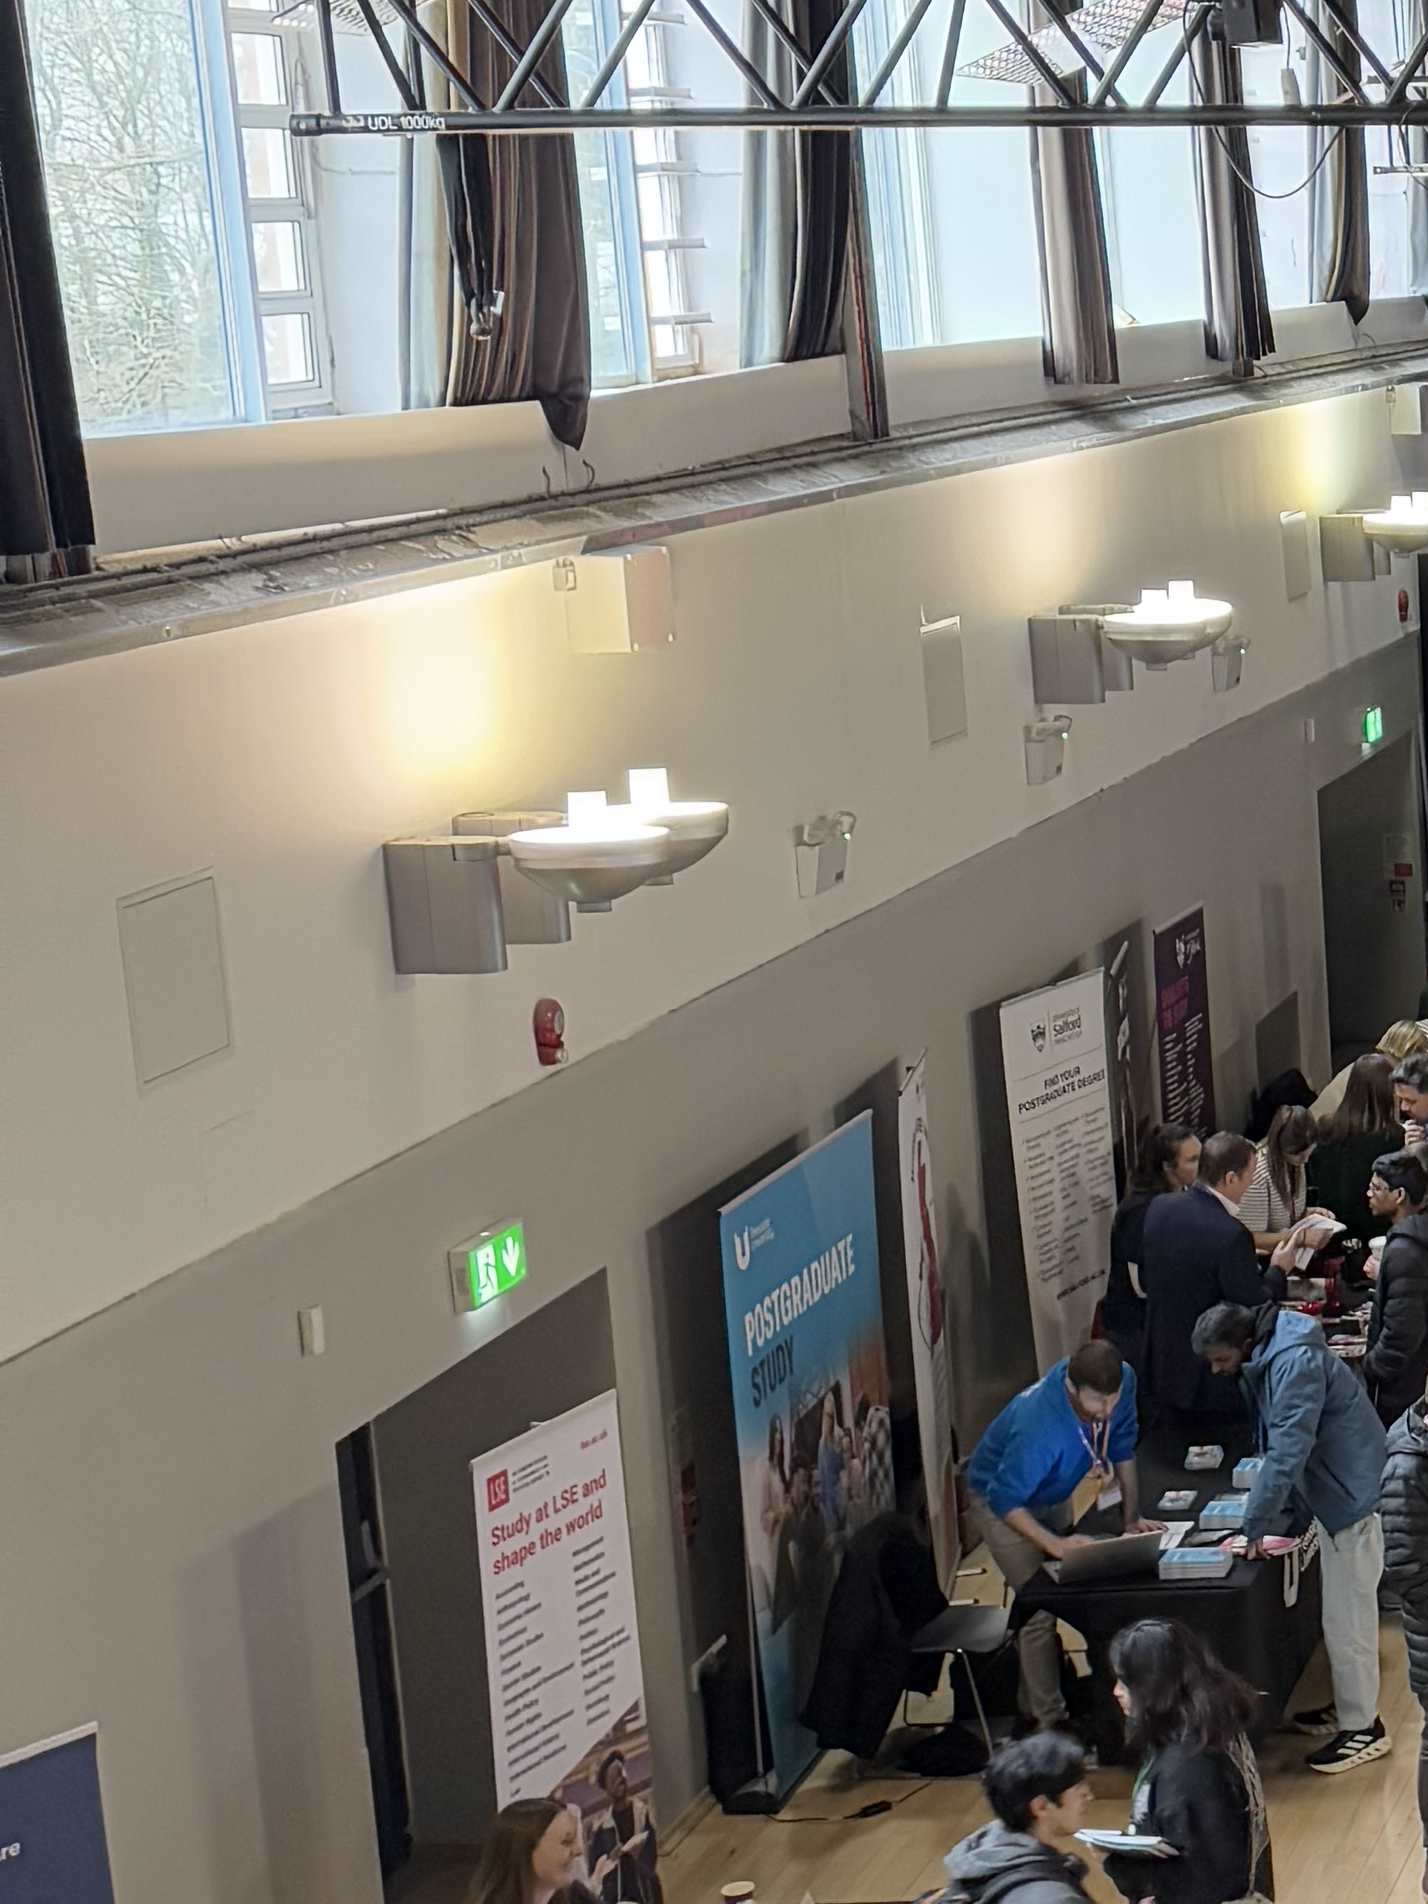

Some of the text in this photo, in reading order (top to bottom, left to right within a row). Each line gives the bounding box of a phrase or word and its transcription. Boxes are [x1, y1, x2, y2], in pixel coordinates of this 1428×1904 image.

[1053, 1013, 1082, 1038] Salford
[1017, 1082, 1076, 1115] POSTGRADUATE
[1059, 1066, 1081, 1085] YOUR
[744, 1233, 855, 1357] POSTGRADUATE
[751, 1336, 794, 1408] STUDY
[489, 1474, 507, 1507] LSE
[491, 1511, 531, 1546] Study
[535, 1501, 550, 1523] at
[553, 1484, 579, 1514] LSE
[582, 1468, 607, 1498] and
[493, 1499, 603, 1575] shape the world
